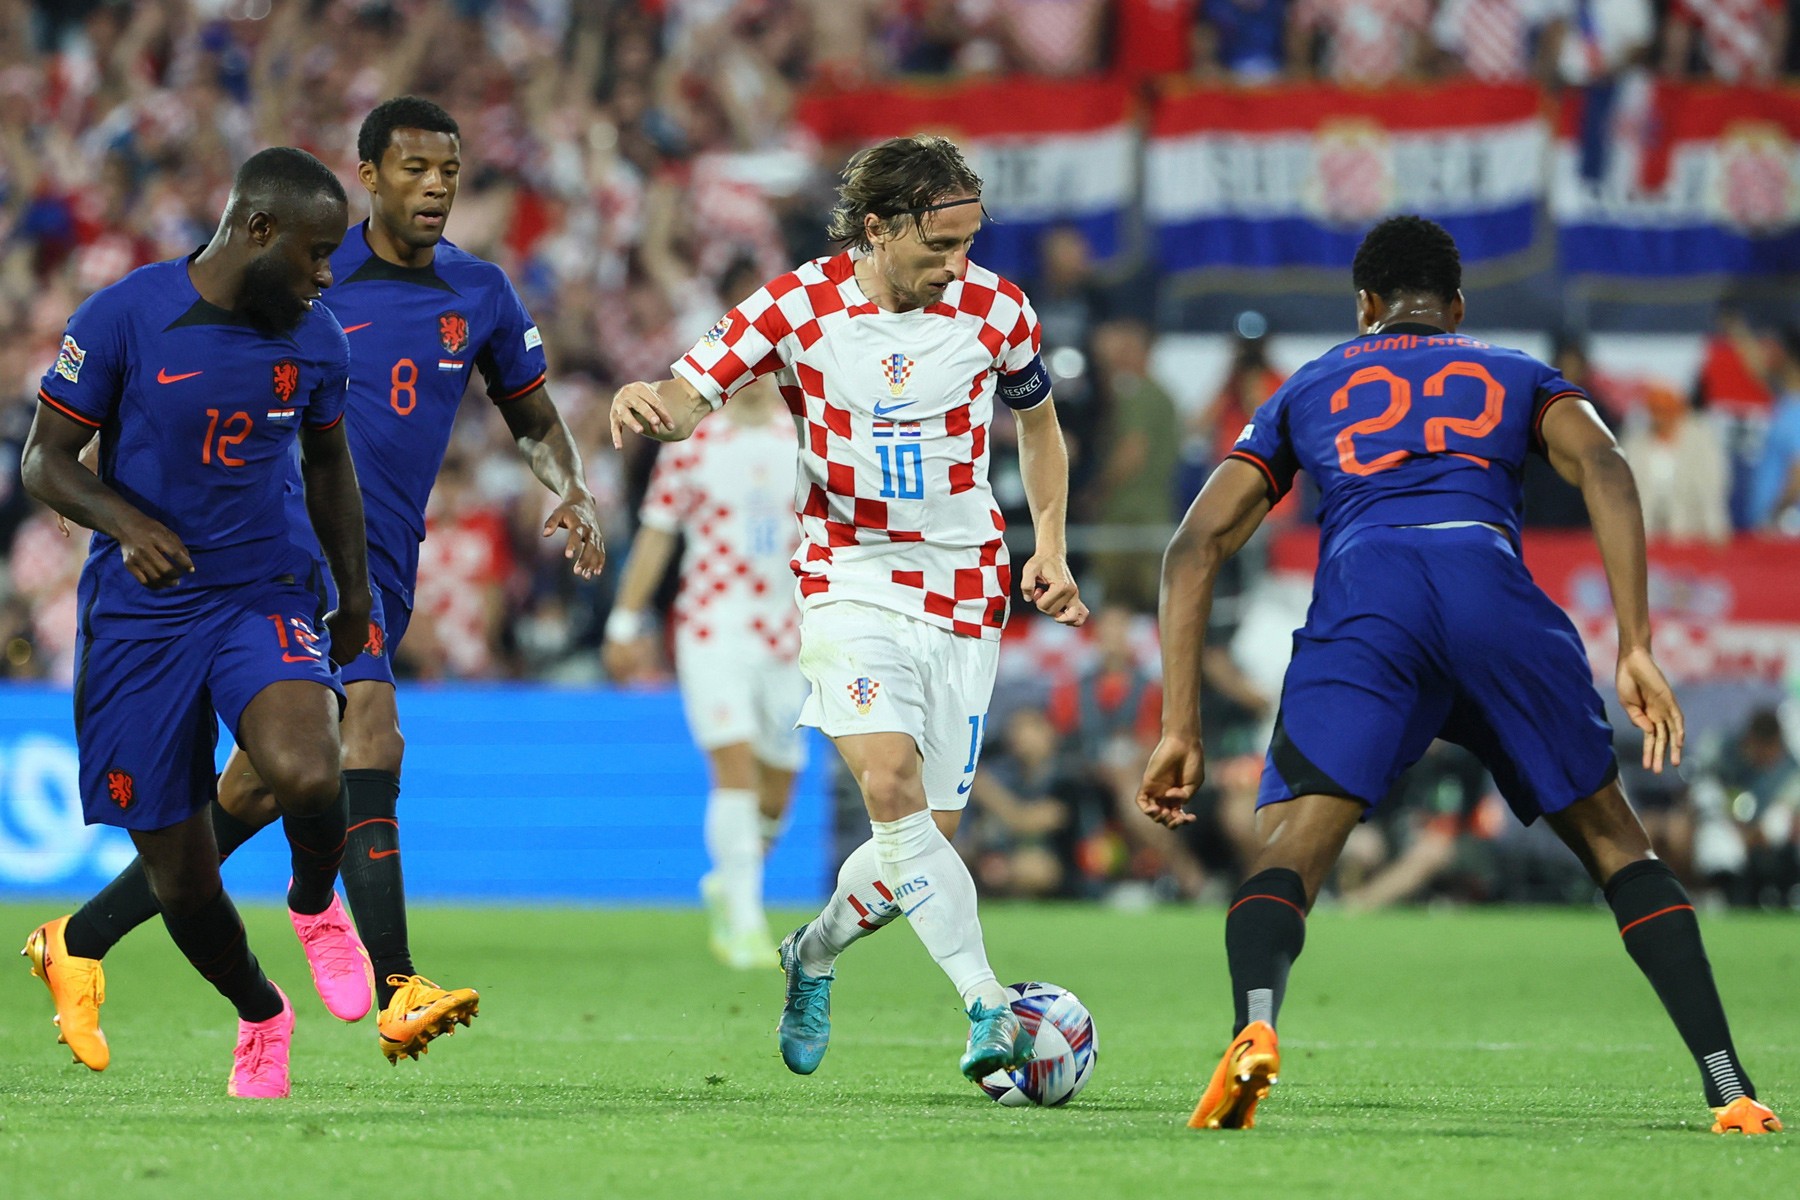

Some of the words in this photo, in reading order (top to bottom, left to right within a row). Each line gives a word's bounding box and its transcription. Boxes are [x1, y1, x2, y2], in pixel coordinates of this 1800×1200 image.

[390, 358, 418, 415] 8
[1003, 375, 1041, 396] RESPECT
[202, 408, 253, 466] 12
[1330, 361, 1506, 476] 22
[876, 444, 924, 499] 10
